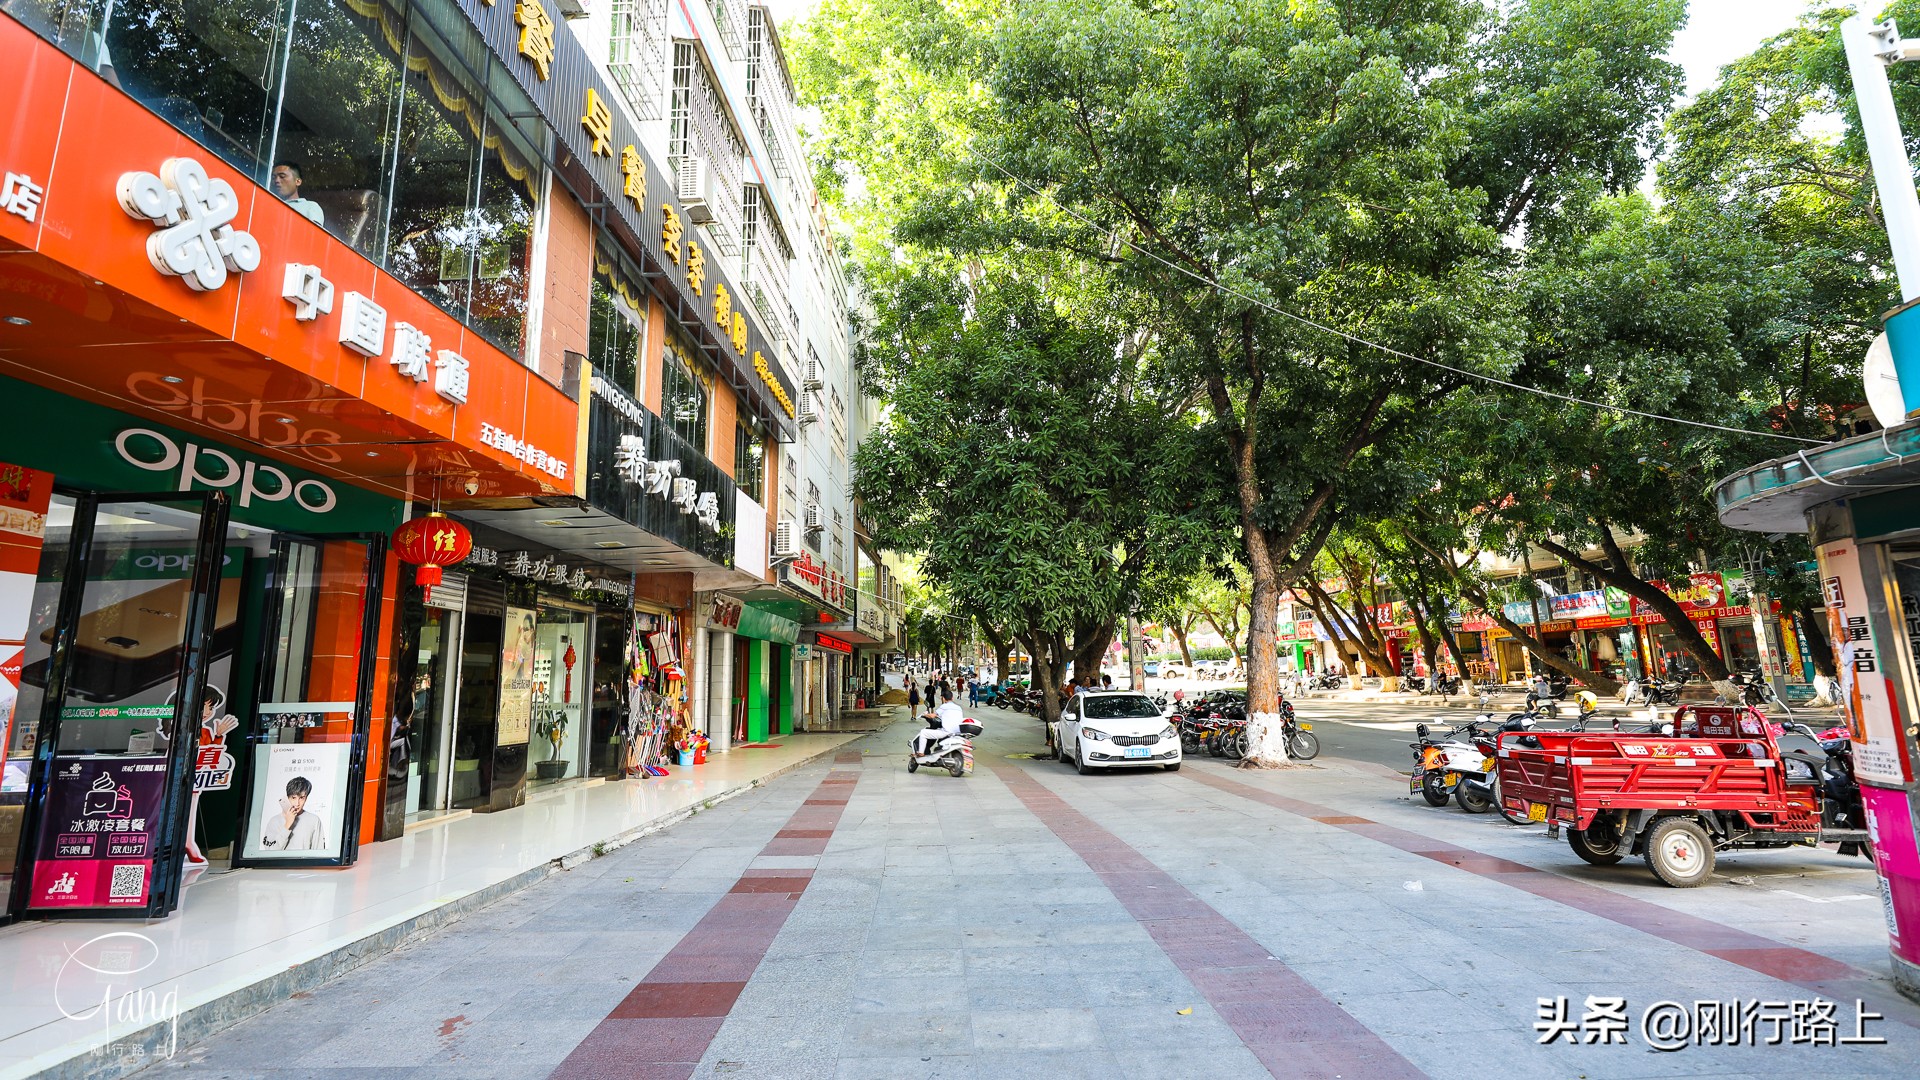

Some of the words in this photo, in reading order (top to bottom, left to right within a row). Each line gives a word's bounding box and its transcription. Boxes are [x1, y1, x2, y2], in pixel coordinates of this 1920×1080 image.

[582, 88, 647, 213] 早餐
[2, 172, 43, 223] 店
[282, 262, 470, 404] 中国联通
[596, 377, 644, 428] JINGGONG
[480, 421, 568, 481] 五指山合作营业厅
[432, 529, 456, 552] 佳
[599, 578, 628, 597] JINGGONG
[1848, 616, 1871, 642] 量
[1853, 647, 1876, 672] 音
[1703, 726, 1732, 735] 福田五星
[196, 747, 224, 770] 真
[1622, 745, 1649, 755] 福田
[70, 819, 145, 832] 冰激凌套餐
[60, 836, 94, 844] 全国流量
[60, 845, 91, 854] 不限量
[111, 836, 146, 844] 全国语音
[111, 845, 142, 854] 放心打
